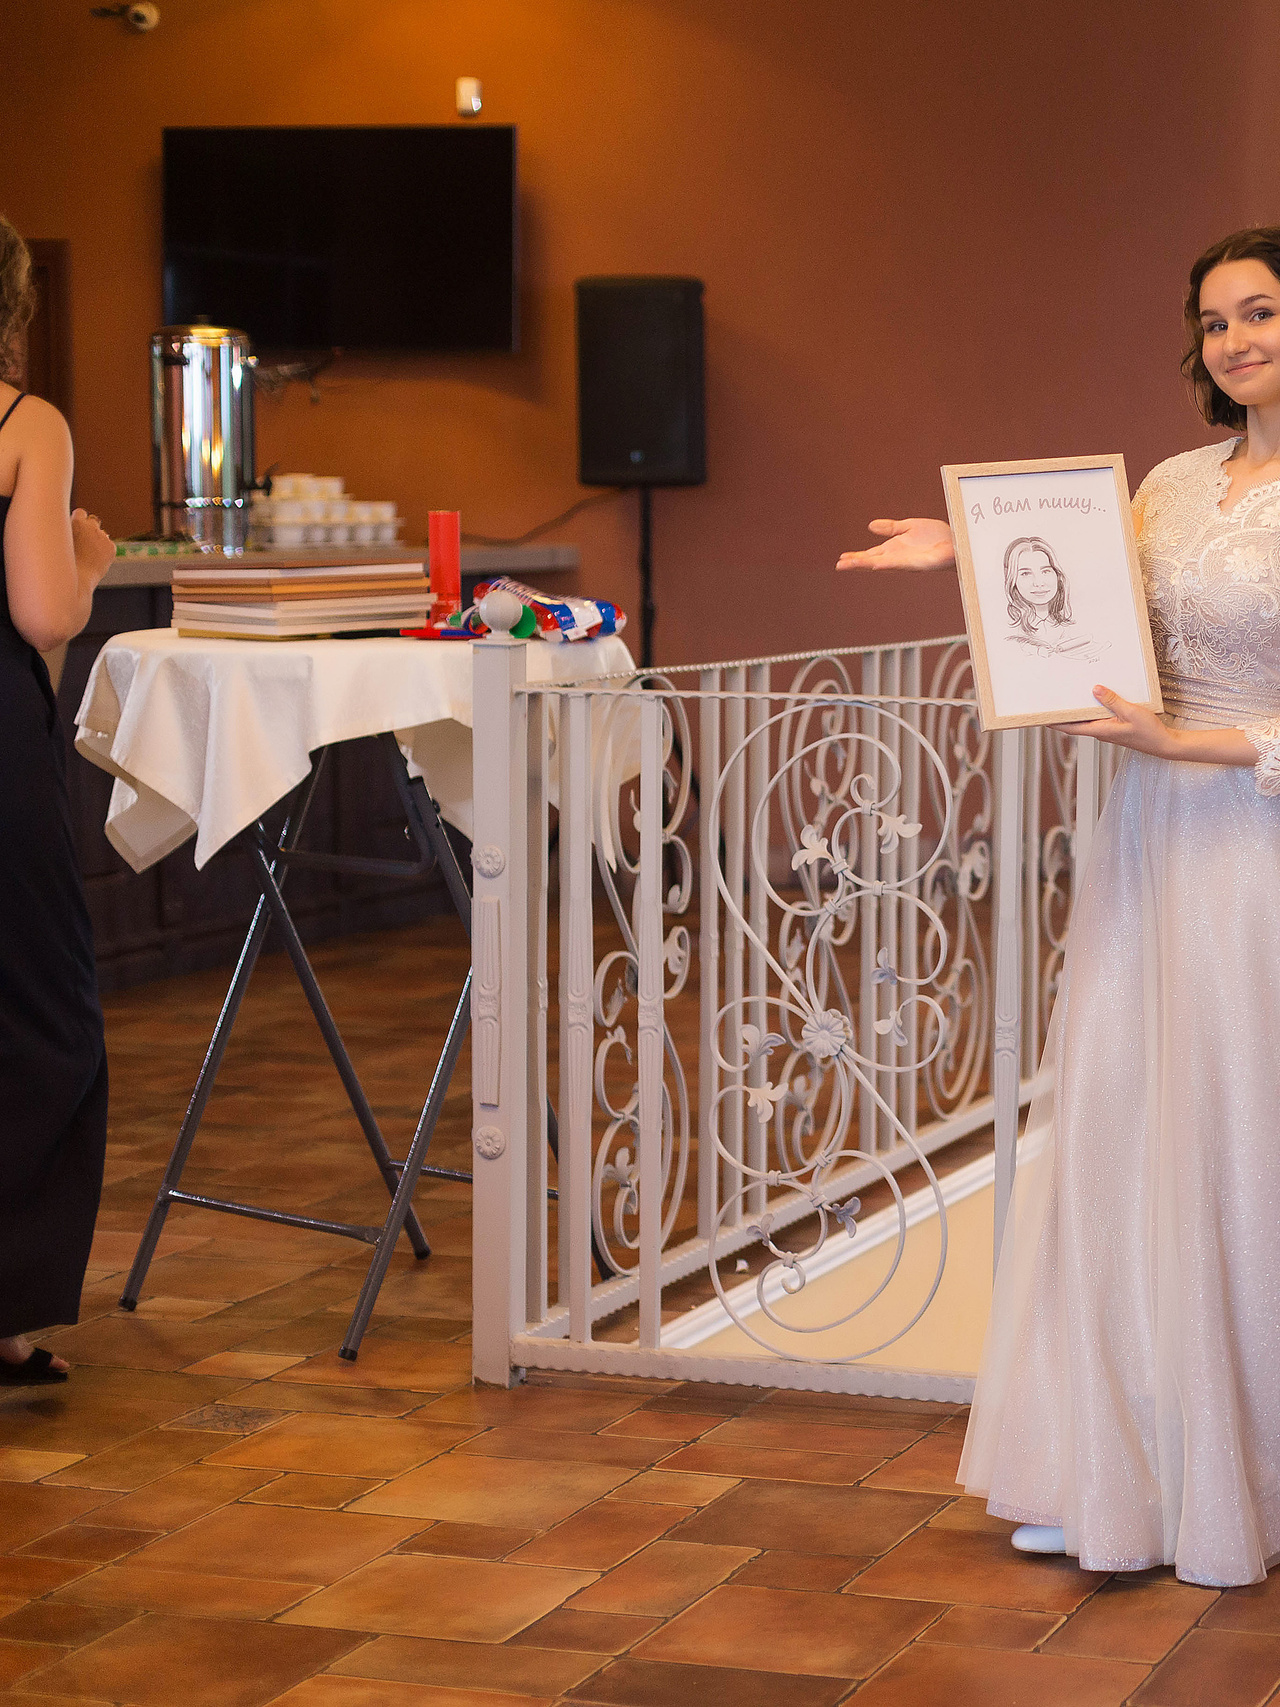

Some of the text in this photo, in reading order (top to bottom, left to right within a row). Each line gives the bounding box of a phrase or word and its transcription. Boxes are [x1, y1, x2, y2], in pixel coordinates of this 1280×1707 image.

[971, 496, 1106, 524] Я вам пишу...
